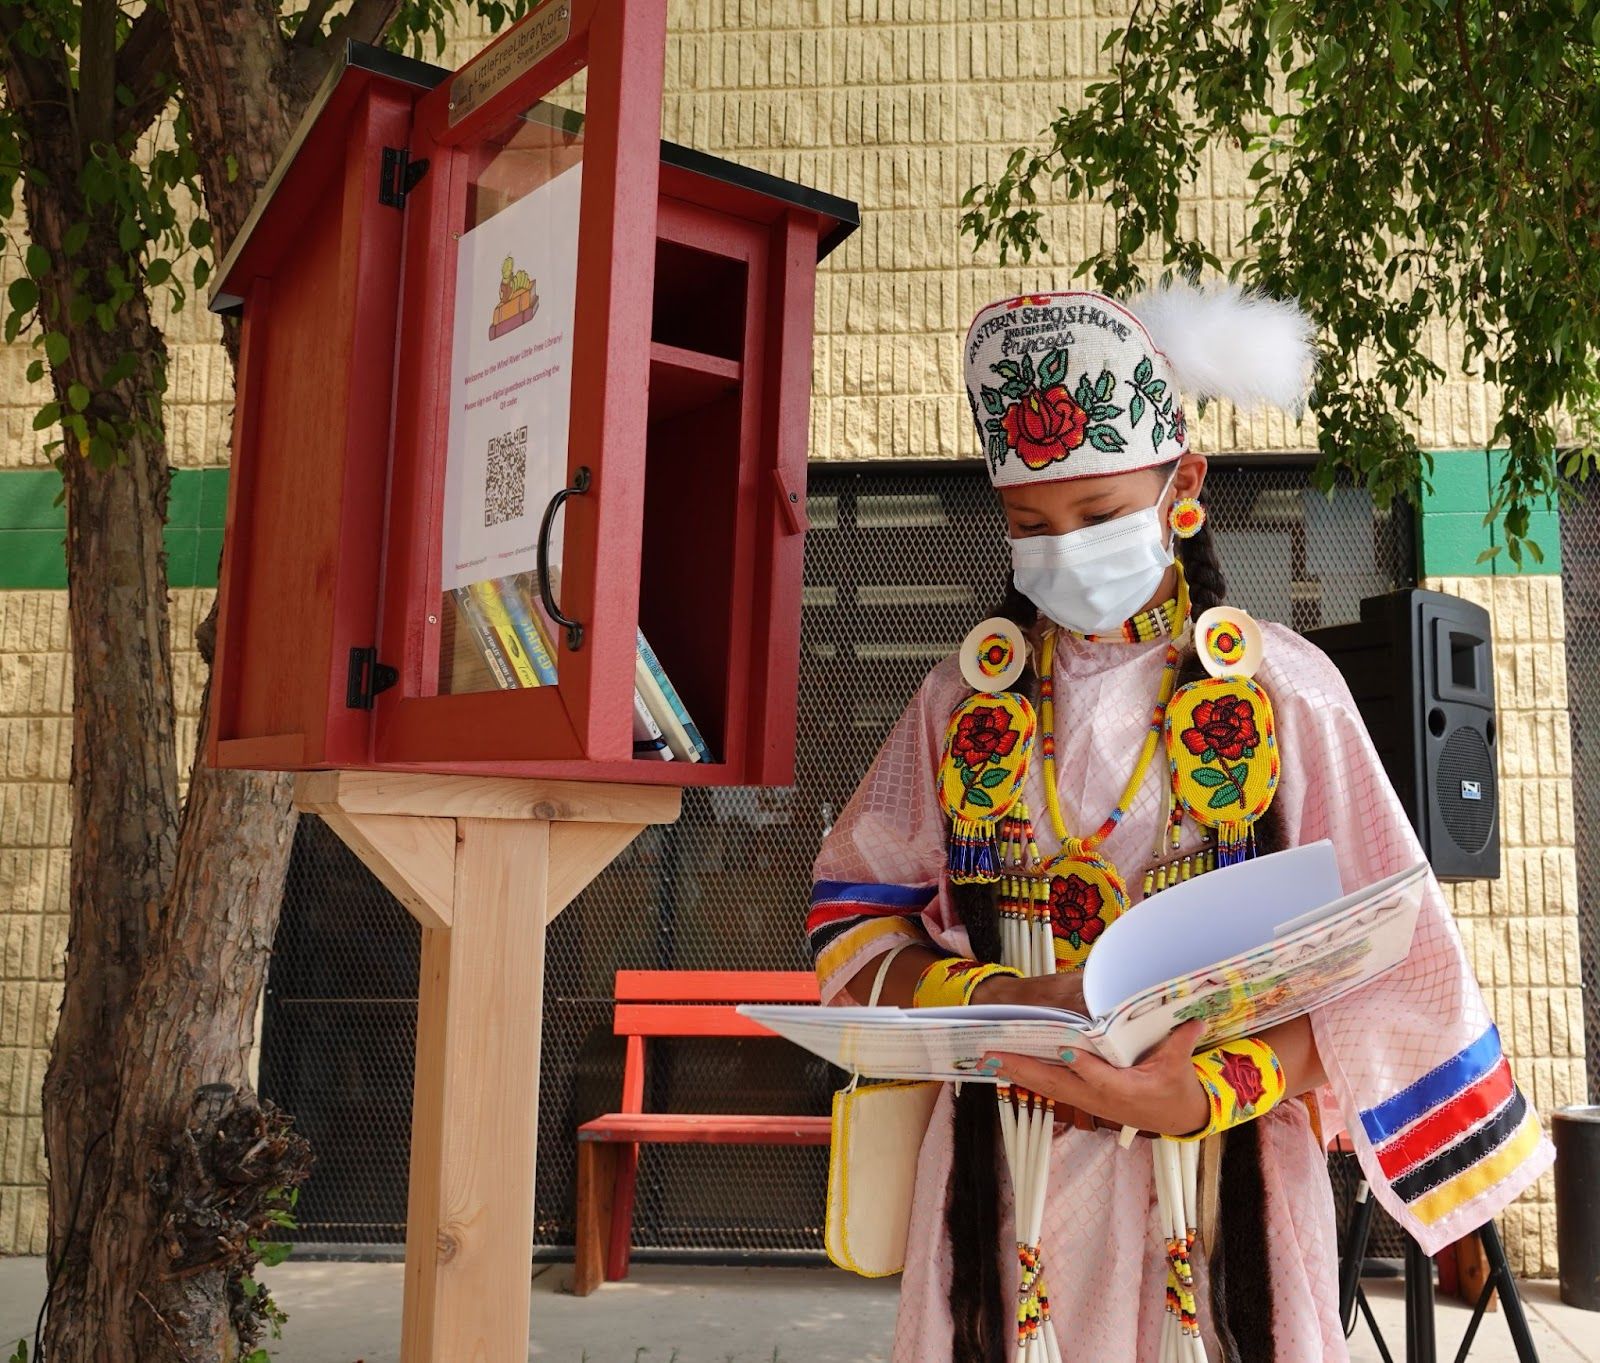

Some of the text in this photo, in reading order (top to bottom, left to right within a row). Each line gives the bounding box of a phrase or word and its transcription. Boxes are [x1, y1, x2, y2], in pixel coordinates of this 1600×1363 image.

[497, 64, 512, 81] Book
[541, 28, 557, 46] Book
[970, 305, 1132, 364] EASTERN SHOSHONE
[1000, 330, 1076, 357] Princess
[465, 371, 484, 385] Welcome
[497, 359, 509, 370] Wind
[509, 354, 521, 364] River
[521, 346, 533, 359] Little
[534, 344, 544, 353] Free
